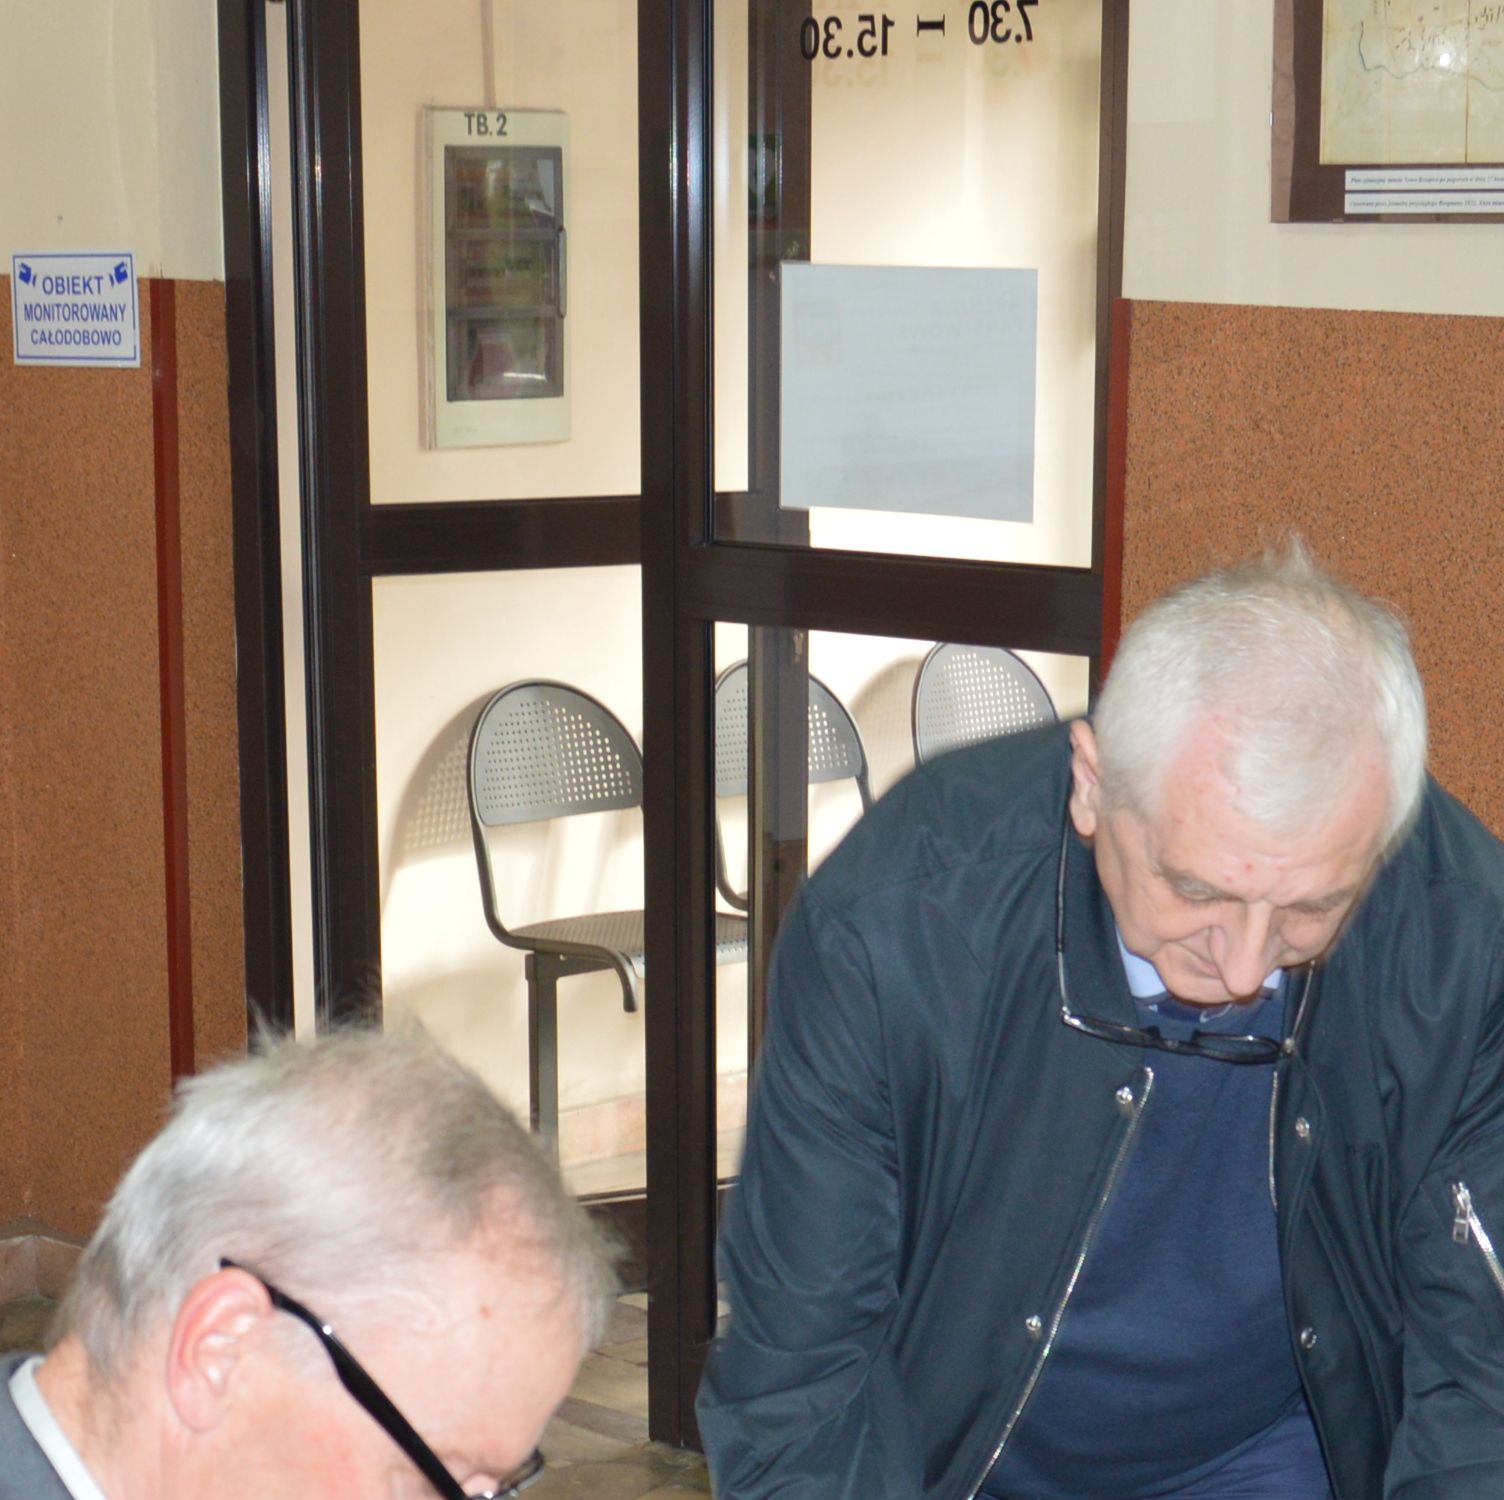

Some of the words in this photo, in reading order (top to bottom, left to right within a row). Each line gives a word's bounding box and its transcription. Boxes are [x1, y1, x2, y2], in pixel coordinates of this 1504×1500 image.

[464, 112, 493, 136] TB.
[496, 112, 508, 136] 2
[42, 275, 104, 295] OBIEKT
[24, 302, 126, 322] MONITOROWANY
[31, 328, 122, 346] CAŁODOBOWO
